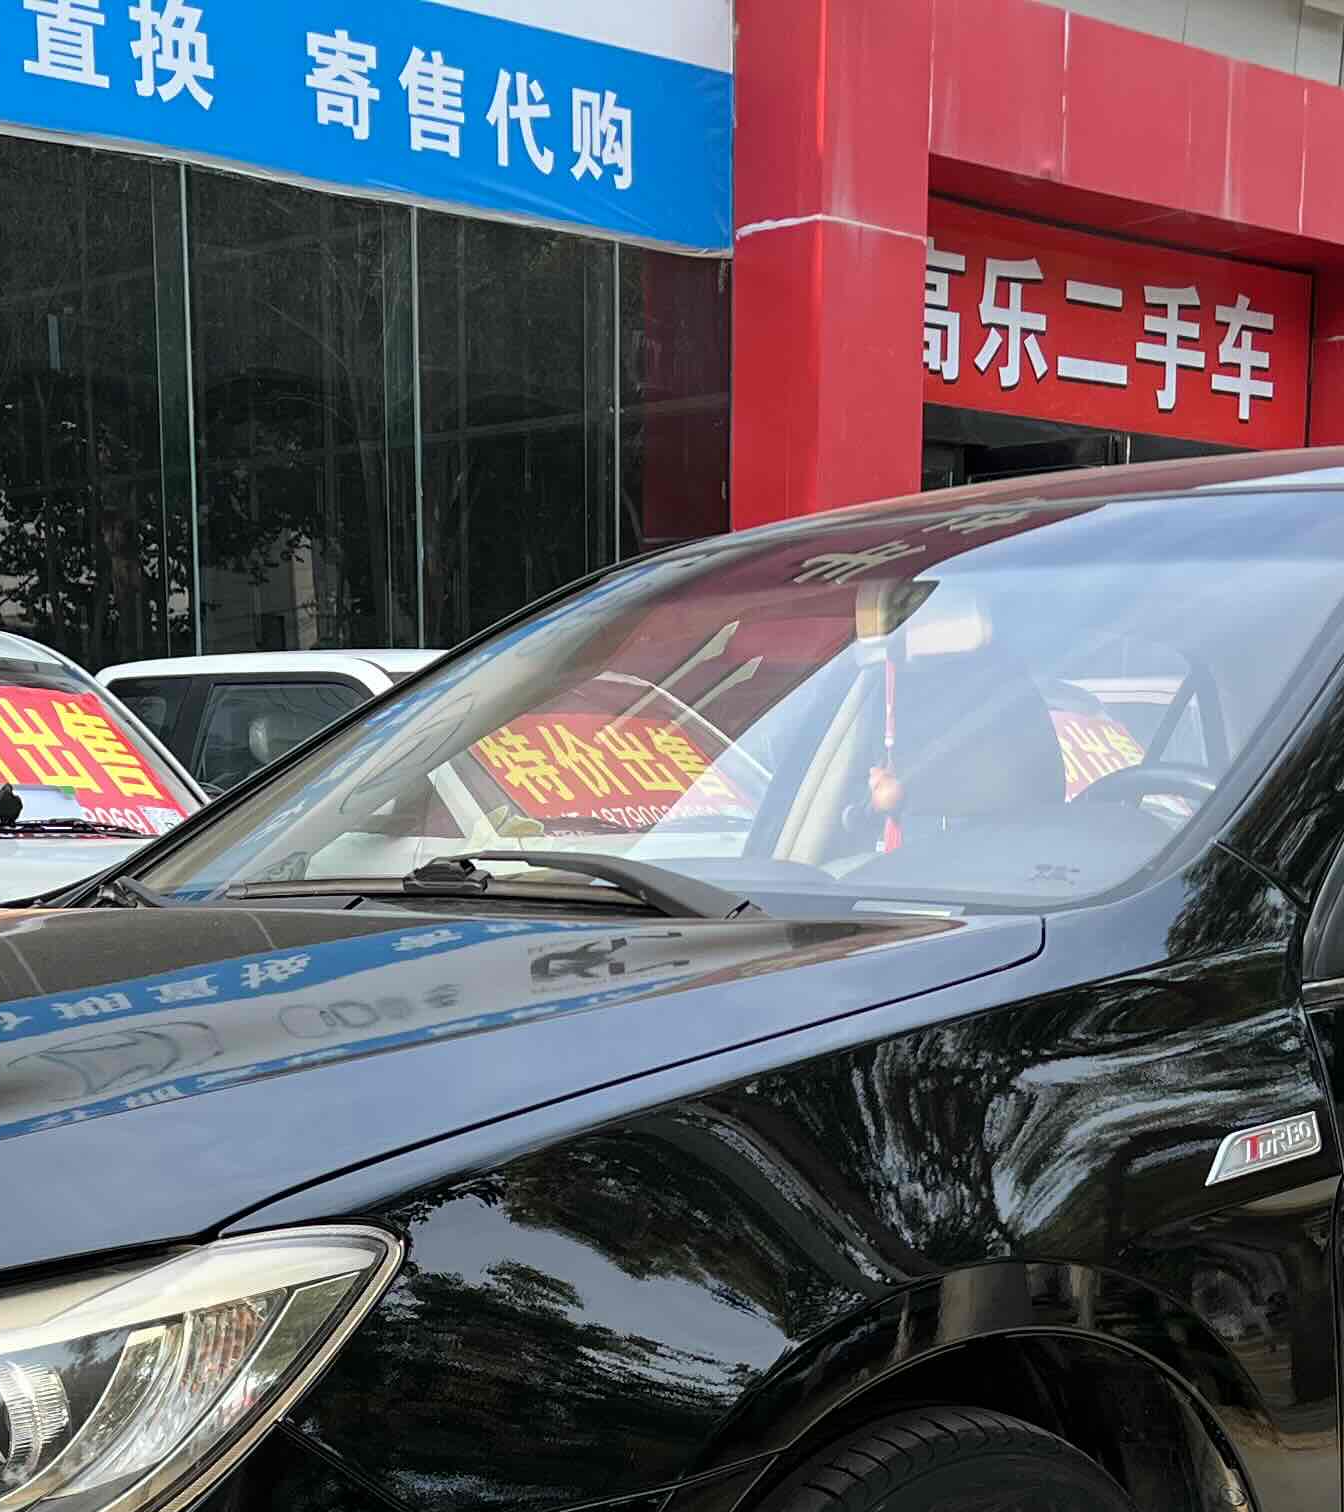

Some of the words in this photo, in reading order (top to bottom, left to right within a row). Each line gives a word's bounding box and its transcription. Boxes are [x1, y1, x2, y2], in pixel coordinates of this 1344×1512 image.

[304, 28, 634, 191] 寄售代购
[477, 720, 738, 805] 特价出售
